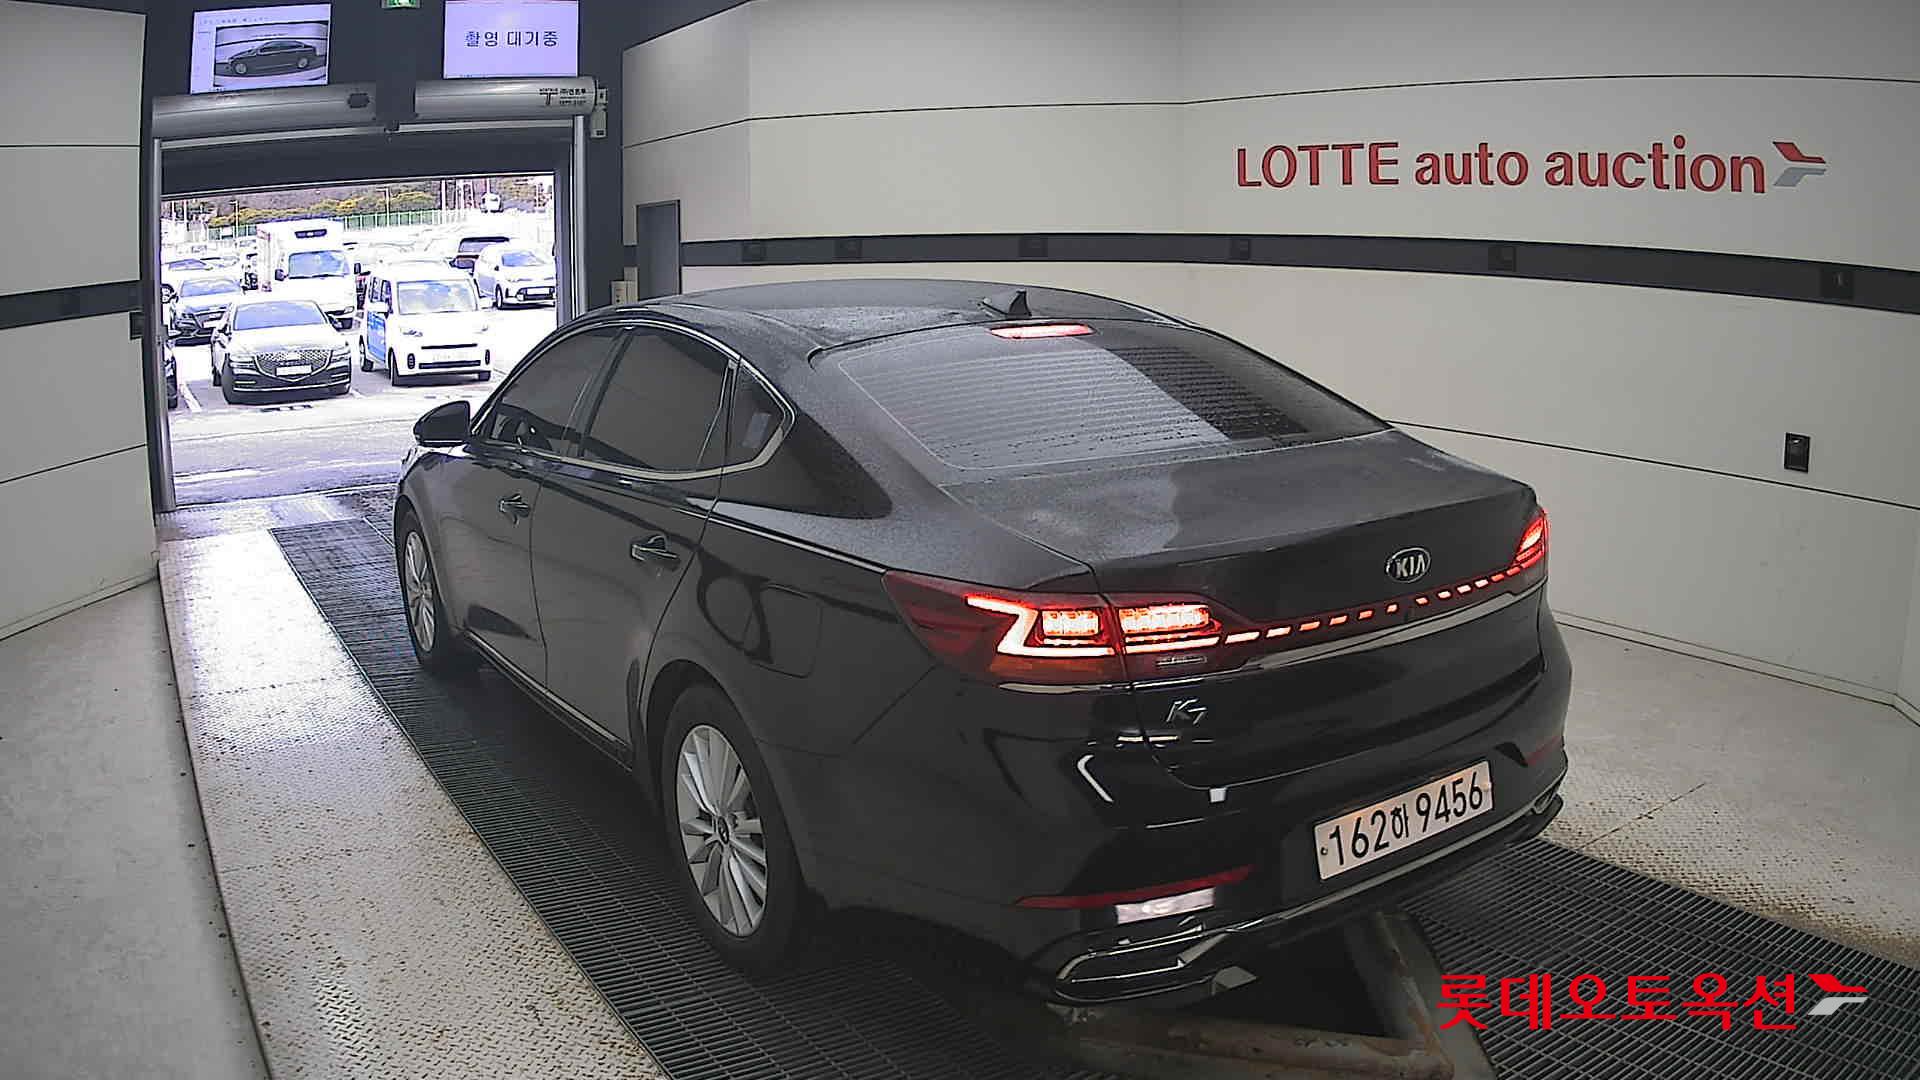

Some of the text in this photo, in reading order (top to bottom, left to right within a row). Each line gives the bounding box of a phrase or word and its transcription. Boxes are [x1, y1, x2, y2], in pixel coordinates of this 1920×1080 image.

[506, 30, 559, 48] 대기중
[1236, 135, 1766, 194] LOTTE auto auction
[1395, 554, 1426, 578] KIA
[1165, 698, 1207, 726] K7
[1329, 771, 1483, 866] 162하 9456
